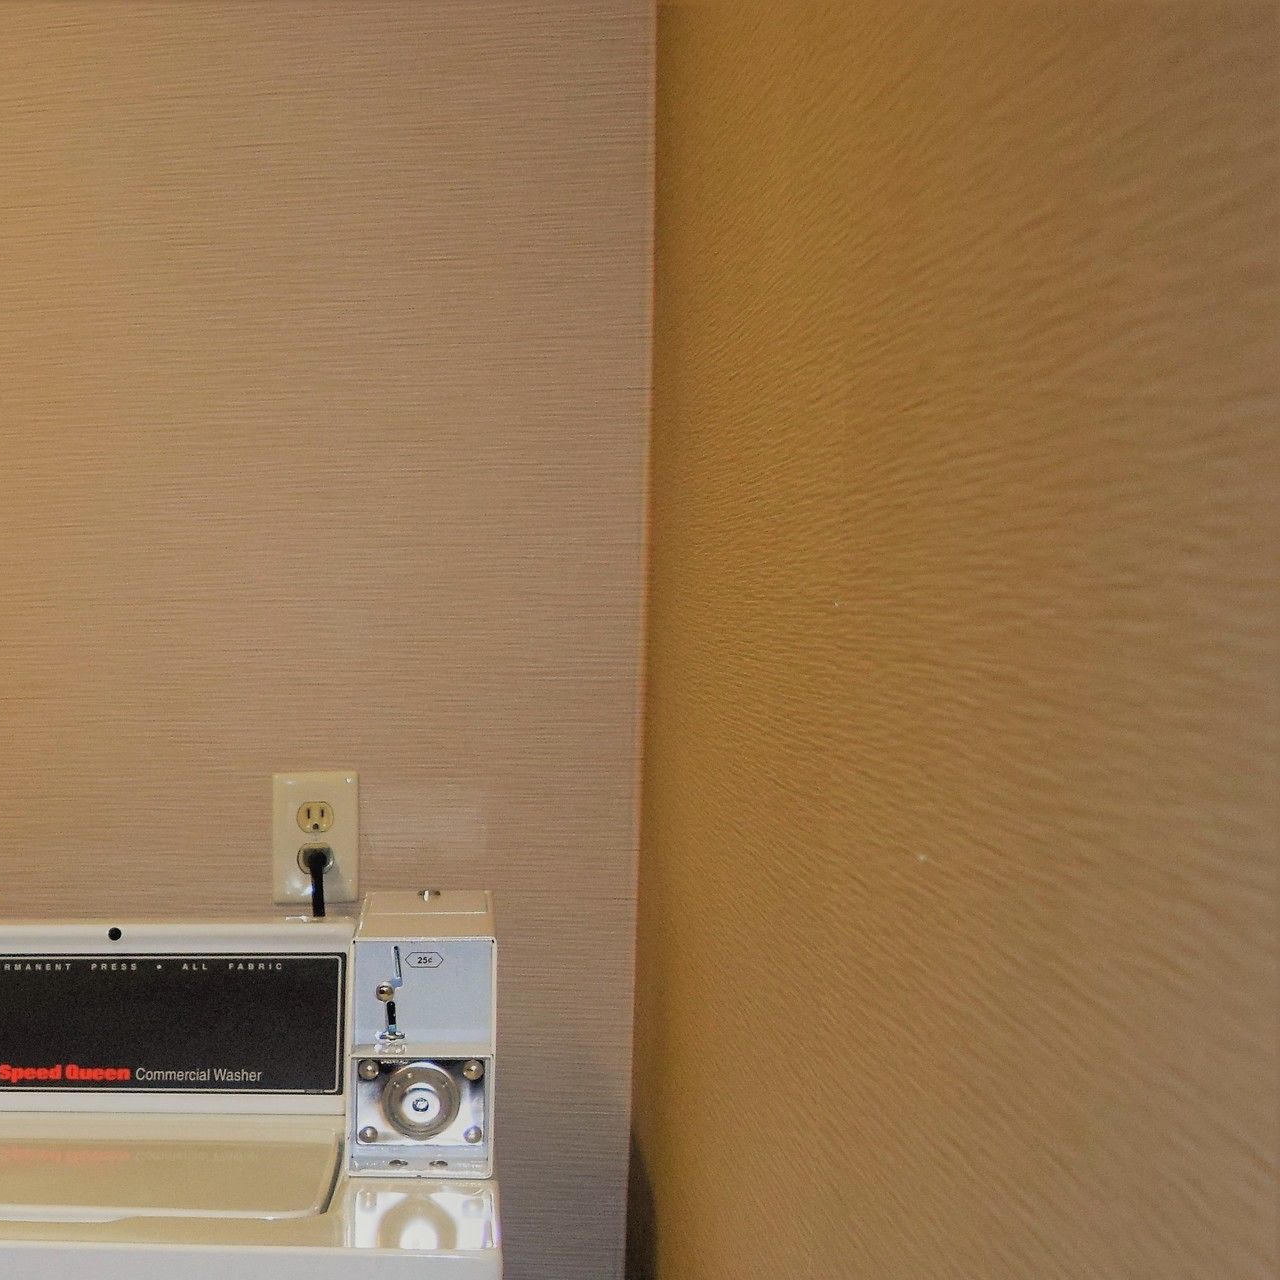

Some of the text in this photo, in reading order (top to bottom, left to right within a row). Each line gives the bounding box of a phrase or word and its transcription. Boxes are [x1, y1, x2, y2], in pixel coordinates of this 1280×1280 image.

[91, 963, 138, 971] PRESS
[182, 963, 209, 971] ALL
[228, 963, 283, 971] FABRIC
[65, 1064, 132, 1081] Queen
[135, 1067, 211, 1082] Commercial
[214, 1067, 262, 1082] Washer
